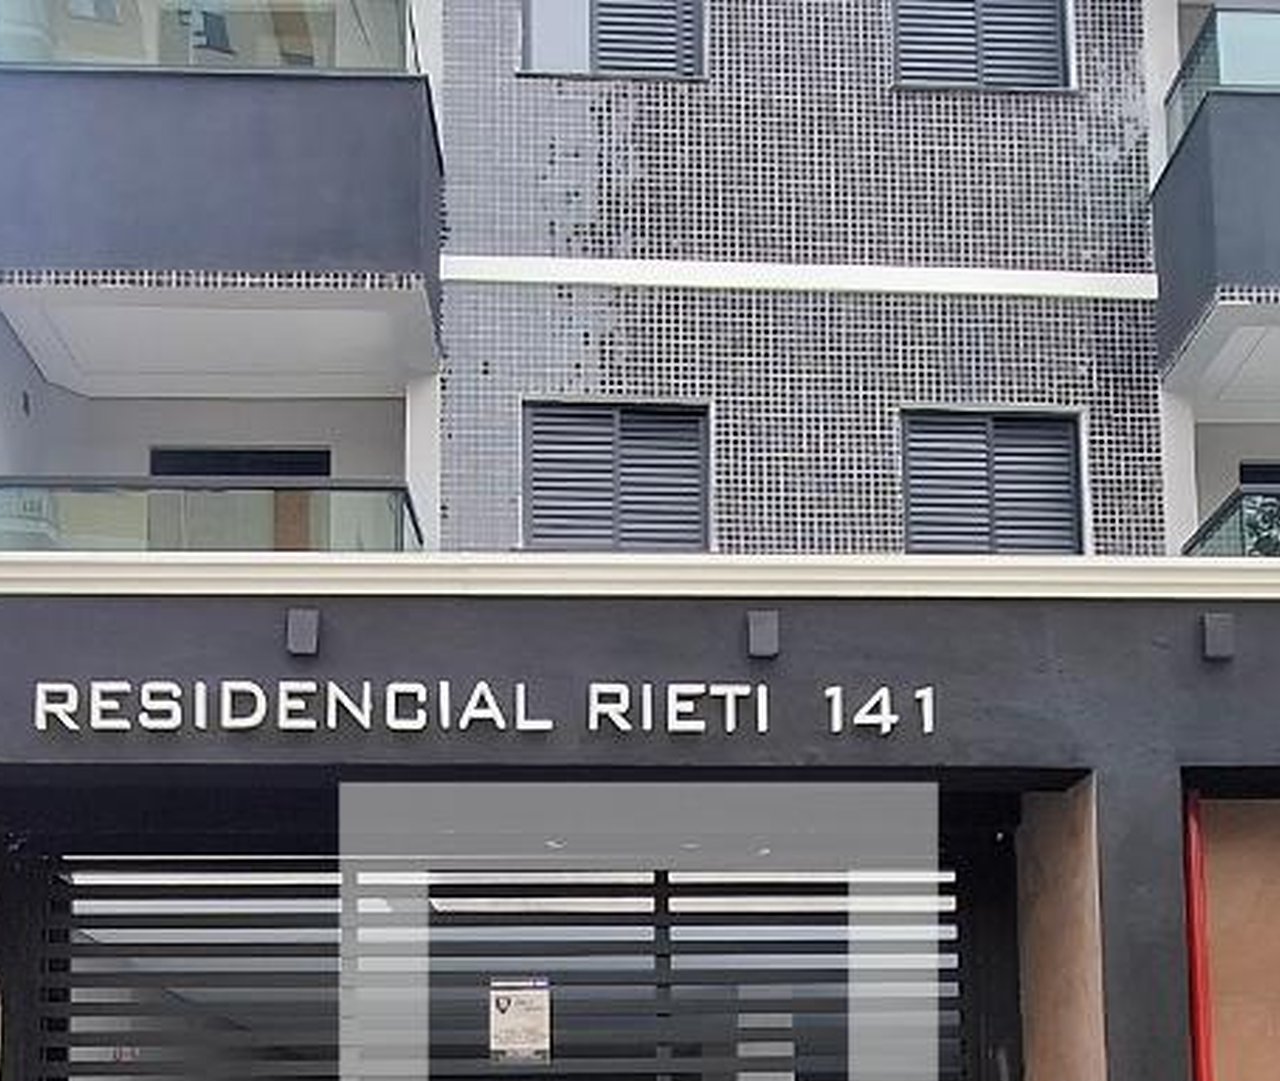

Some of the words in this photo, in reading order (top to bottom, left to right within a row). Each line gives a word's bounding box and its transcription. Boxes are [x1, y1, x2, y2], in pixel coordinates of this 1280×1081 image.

[34, 681, 554, 731] RESIDENCIAL
[587, 682, 769, 733] RIETI
[823, 685, 935, 734] 141
